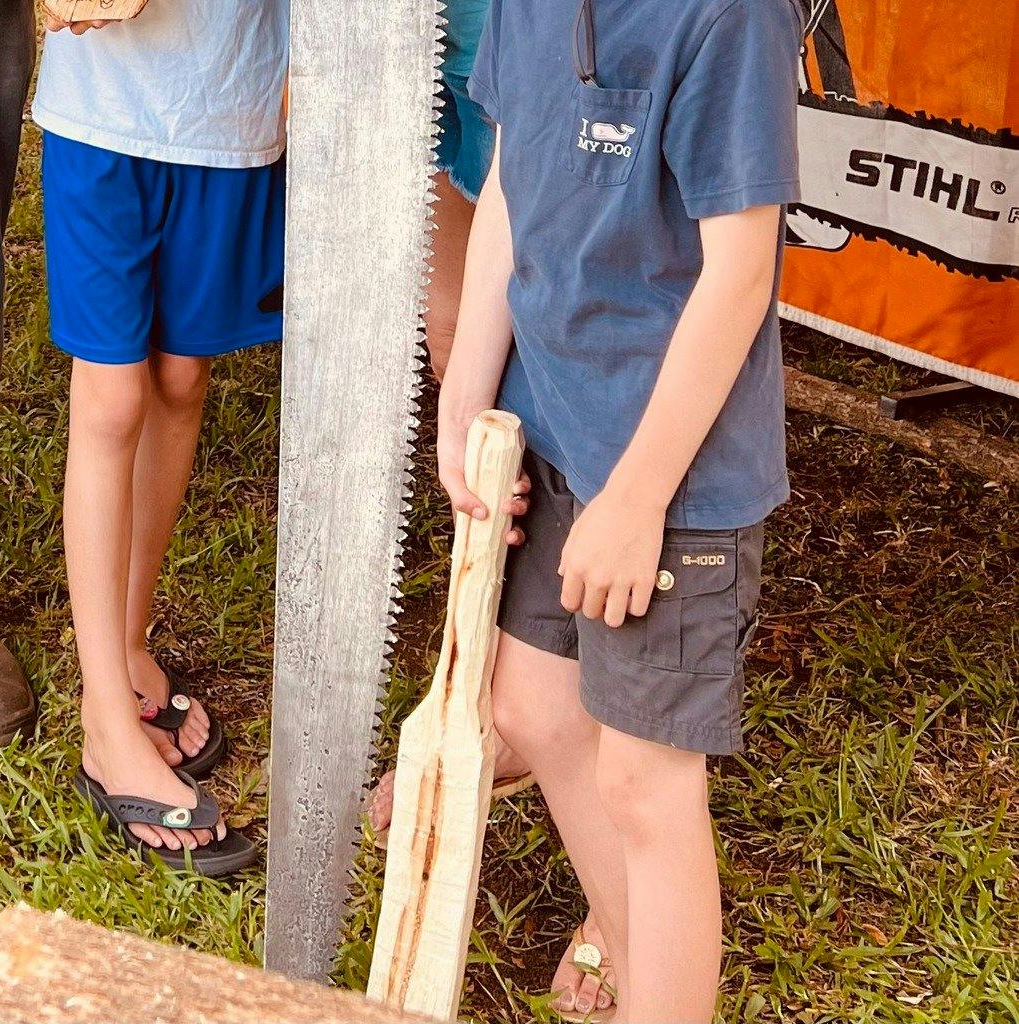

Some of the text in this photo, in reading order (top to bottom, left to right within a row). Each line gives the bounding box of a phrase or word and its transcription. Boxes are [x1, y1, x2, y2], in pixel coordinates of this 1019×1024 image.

[579, 117, 589, 137] I
[576, 136, 633, 159] MY DOG
[682, 555, 726, 566] G-1000
